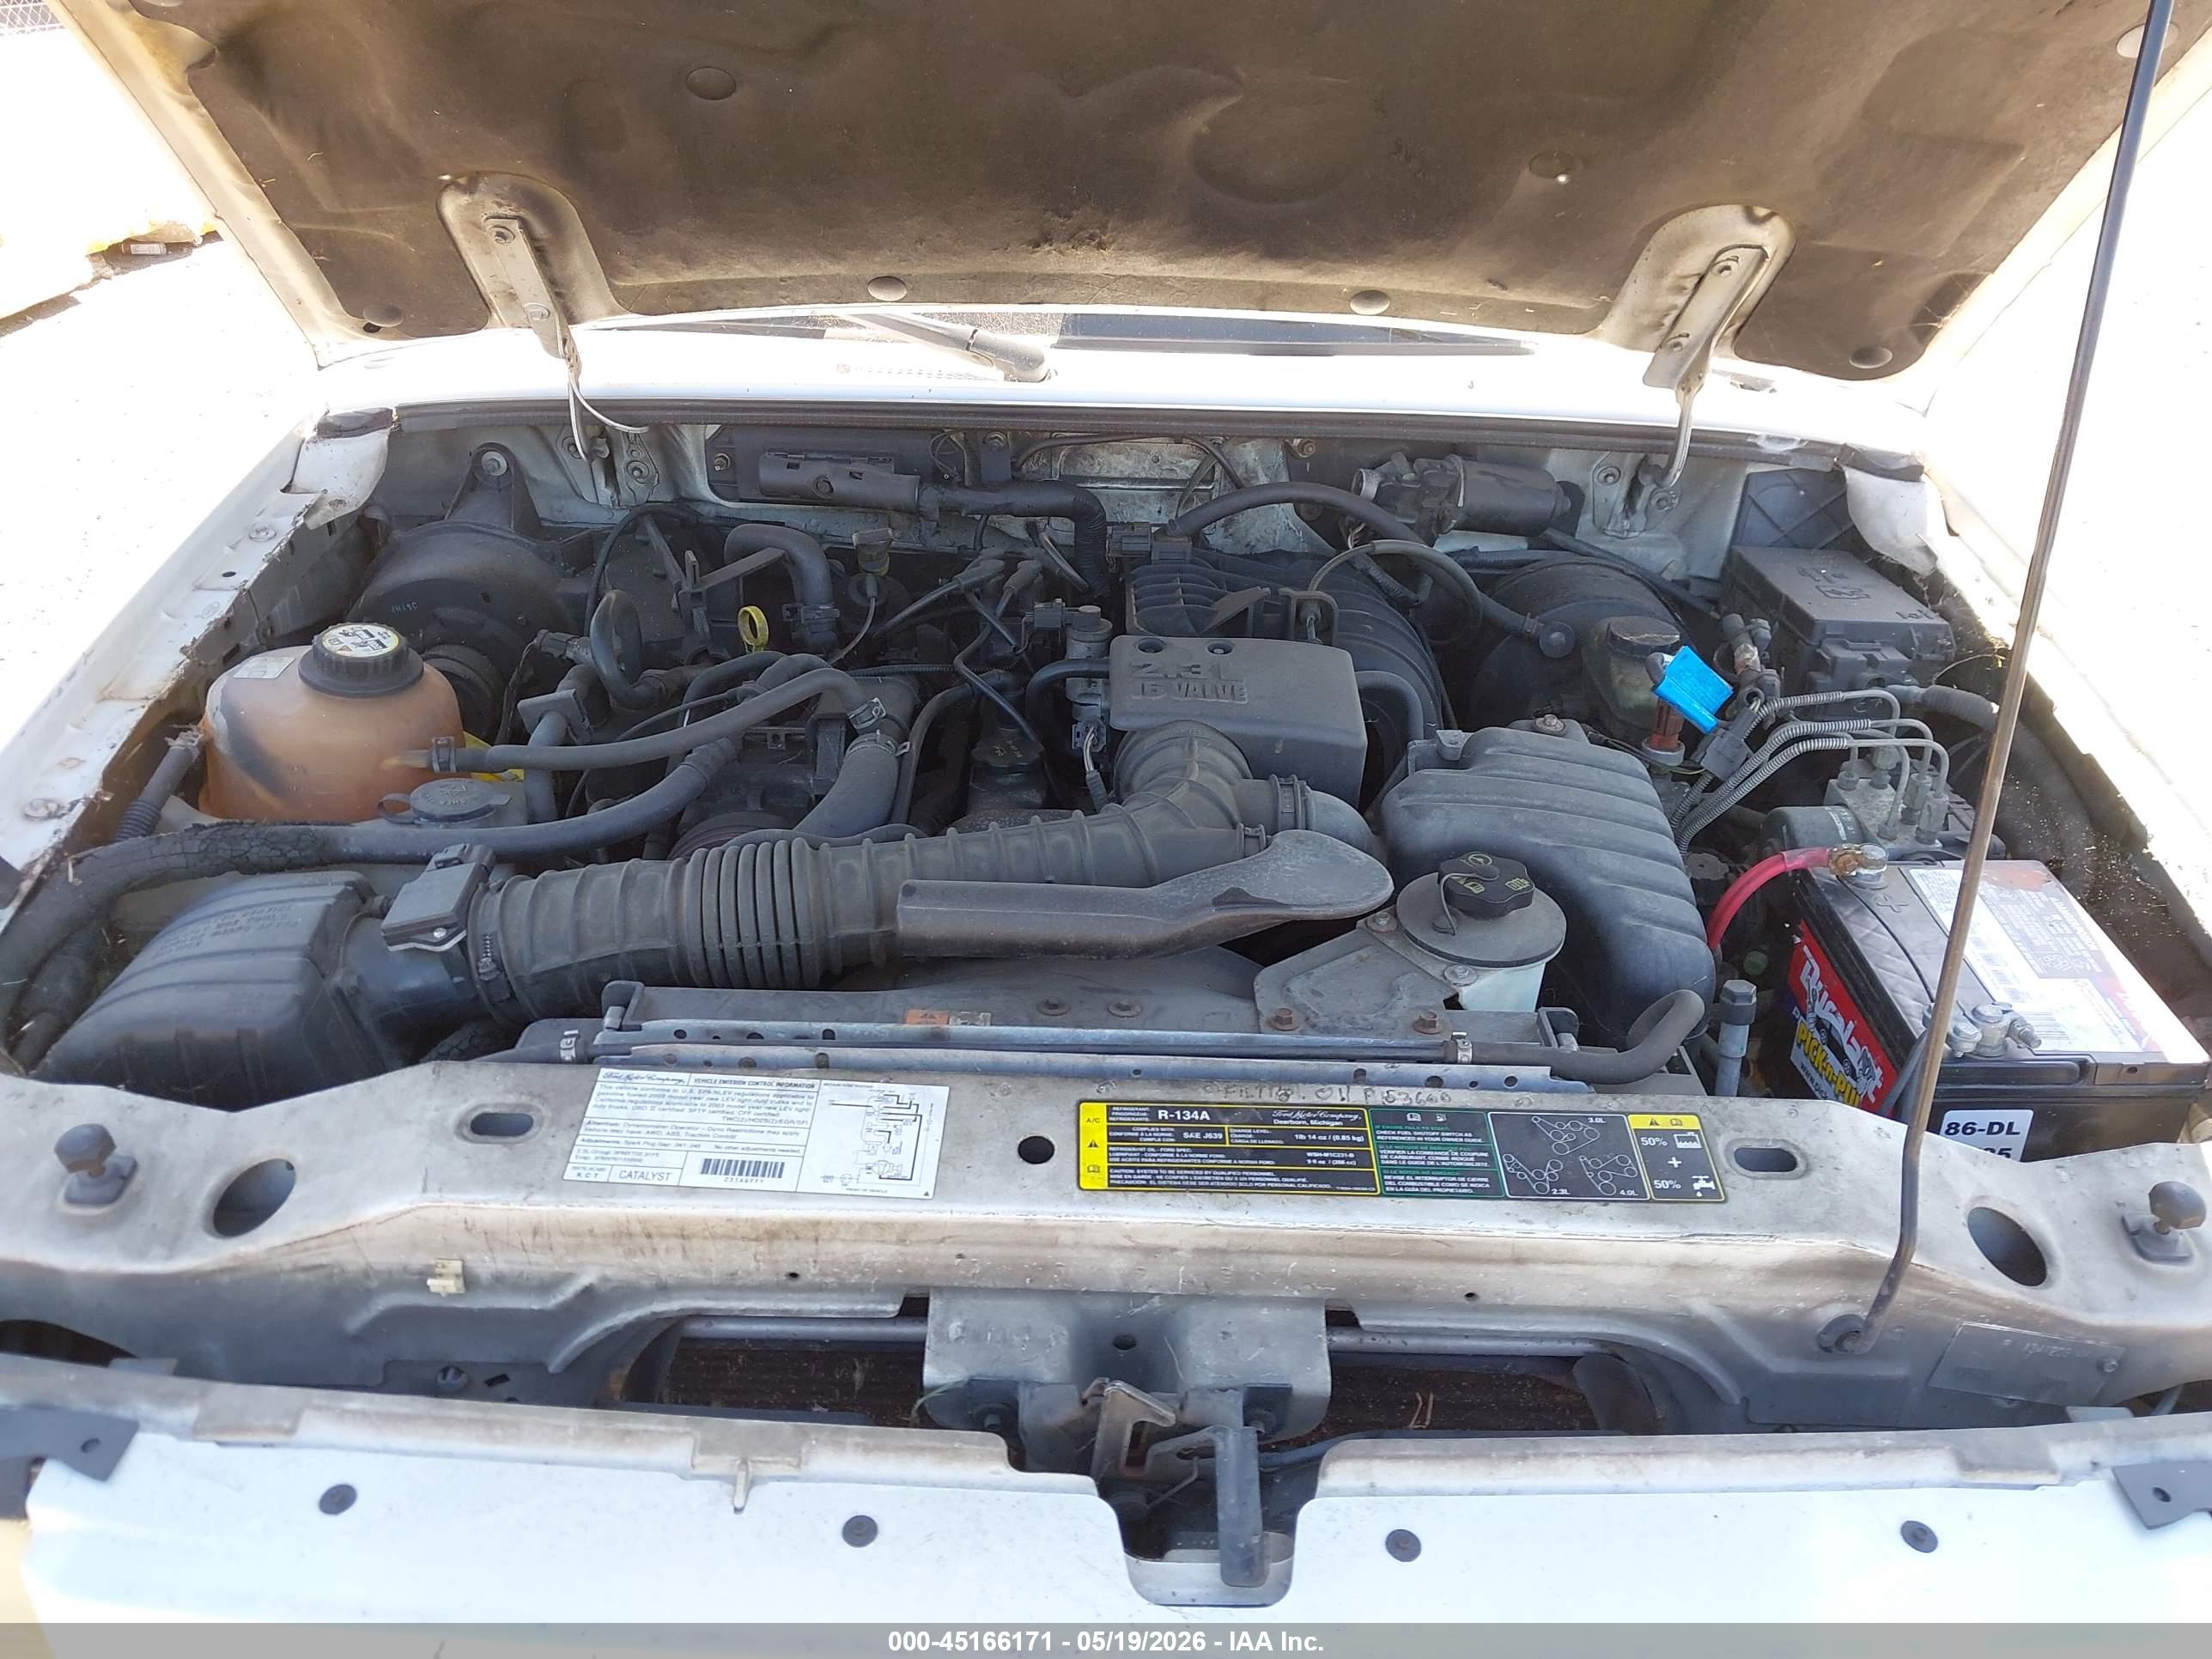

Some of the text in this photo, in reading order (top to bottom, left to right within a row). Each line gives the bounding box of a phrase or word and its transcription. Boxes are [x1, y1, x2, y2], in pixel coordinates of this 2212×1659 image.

[1129, 661, 1244, 683] 2.3L
[1172, 683, 1248, 704] VALVE
[1158, 1109, 1210, 1120] R-134A
[1944, 1121, 2021, 1136] 86-DL
[1641, 1137, 1668, 1146] 50%
[617, 1170, 672, 1182] CATALYST
[1653, 1180, 1682, 1189] 50%
